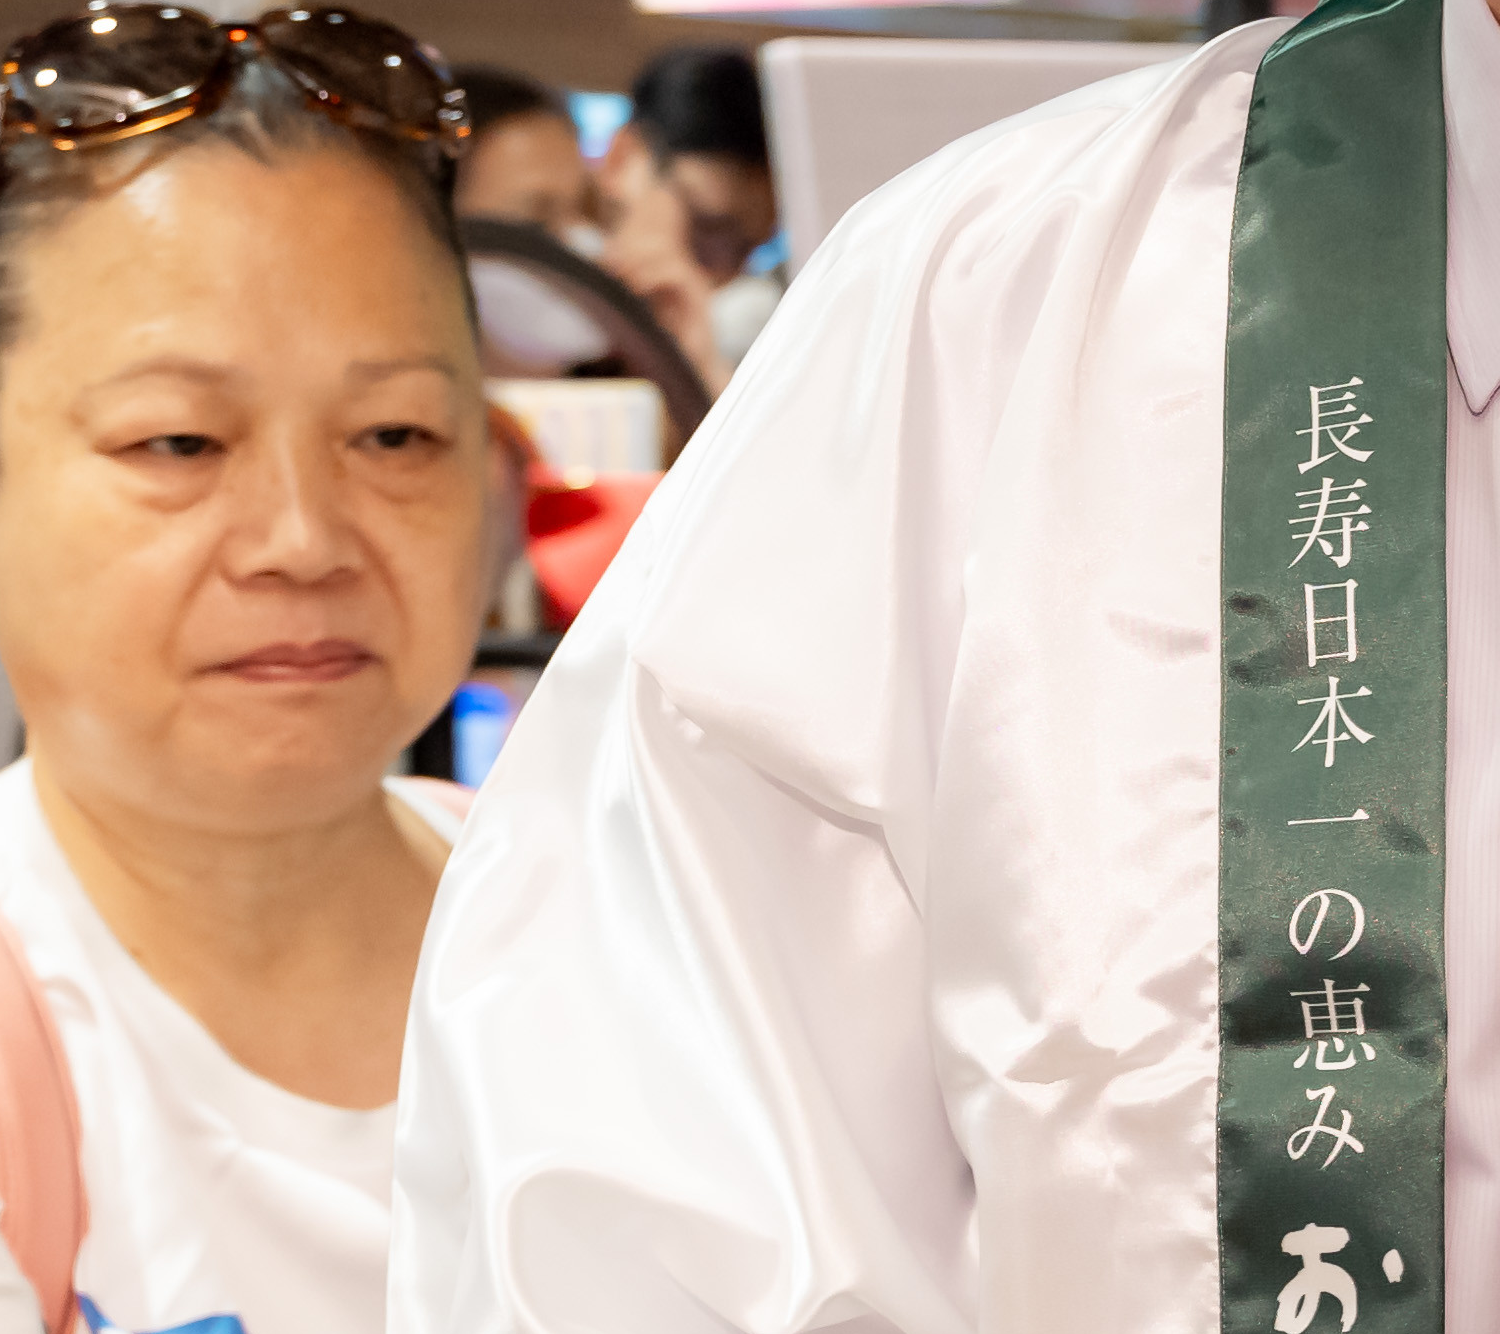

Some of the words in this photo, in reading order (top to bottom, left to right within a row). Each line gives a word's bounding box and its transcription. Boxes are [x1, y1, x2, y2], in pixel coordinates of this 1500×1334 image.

[1286, 375, 1377, 1172] 長寿日本一の恵み
